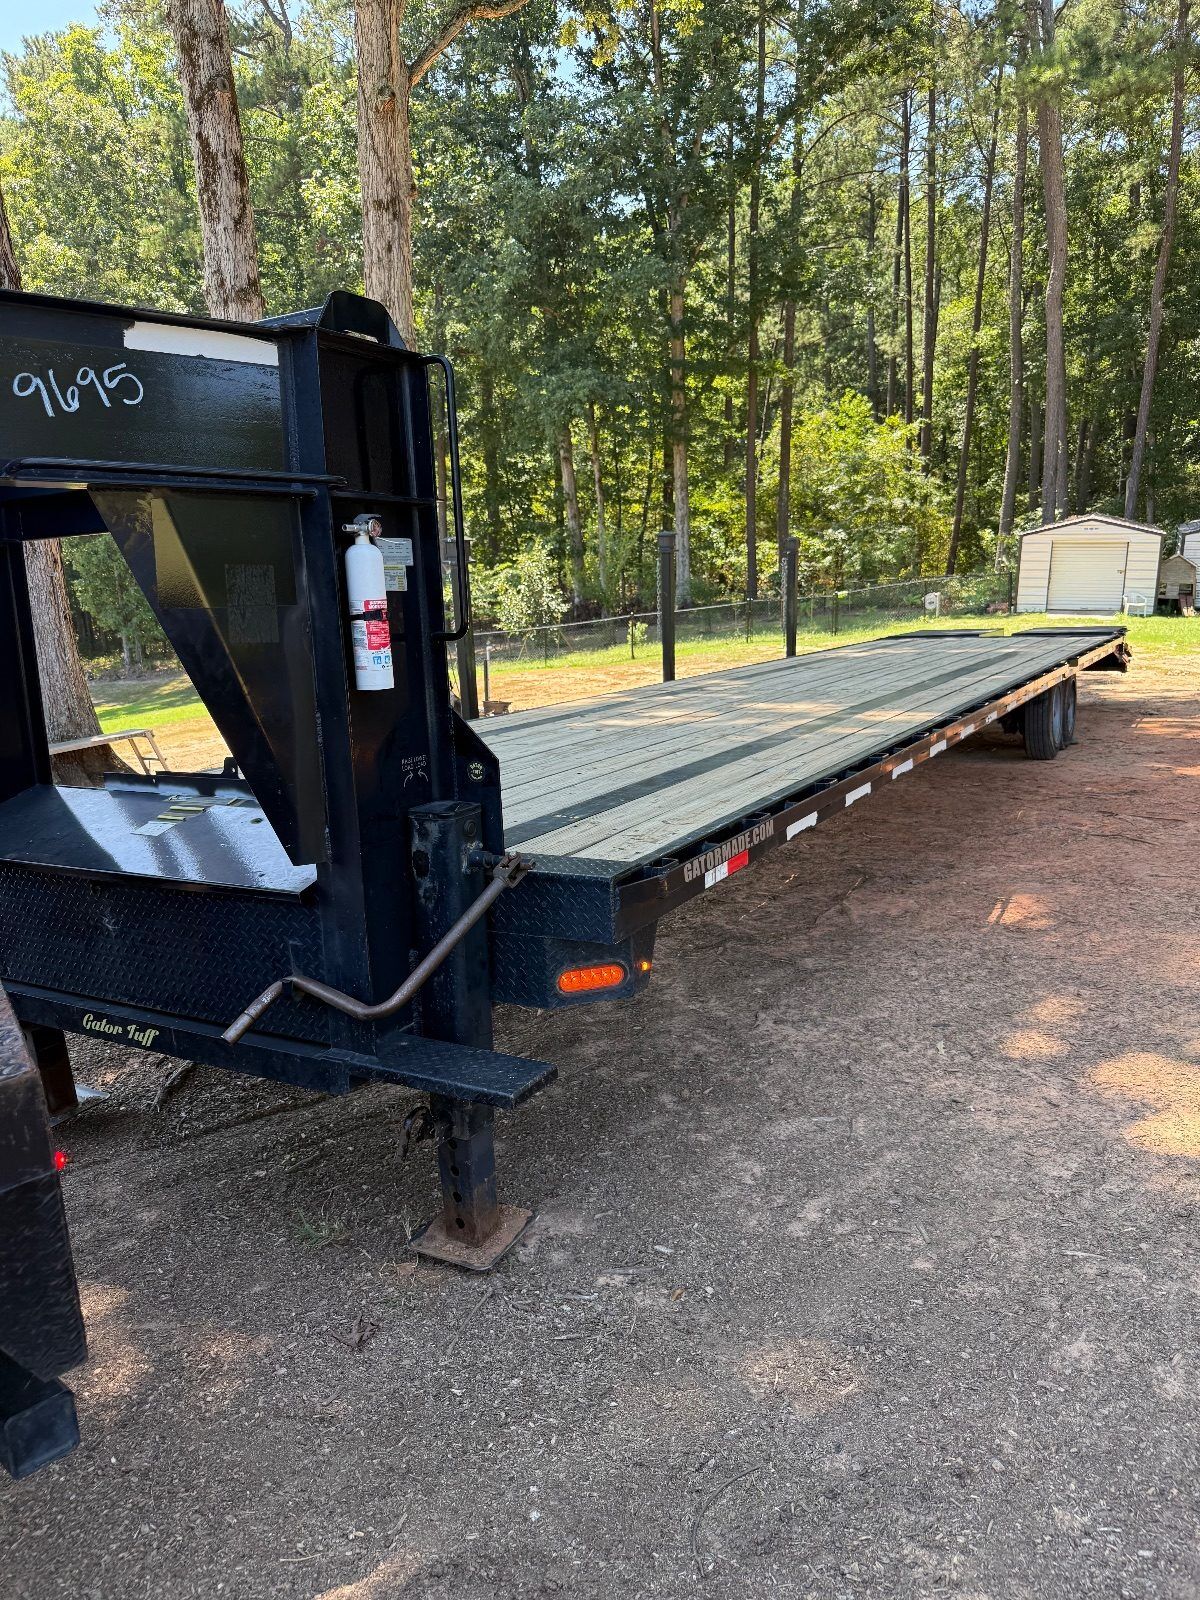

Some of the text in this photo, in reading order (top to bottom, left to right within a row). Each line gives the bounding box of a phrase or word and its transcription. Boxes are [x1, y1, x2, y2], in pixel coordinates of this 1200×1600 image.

[12, 362, 144, 417] 9695
[683, 819, 775, 883] GATORMADE.COM
[82, 1013, 160, 1047] Gator Tuff
